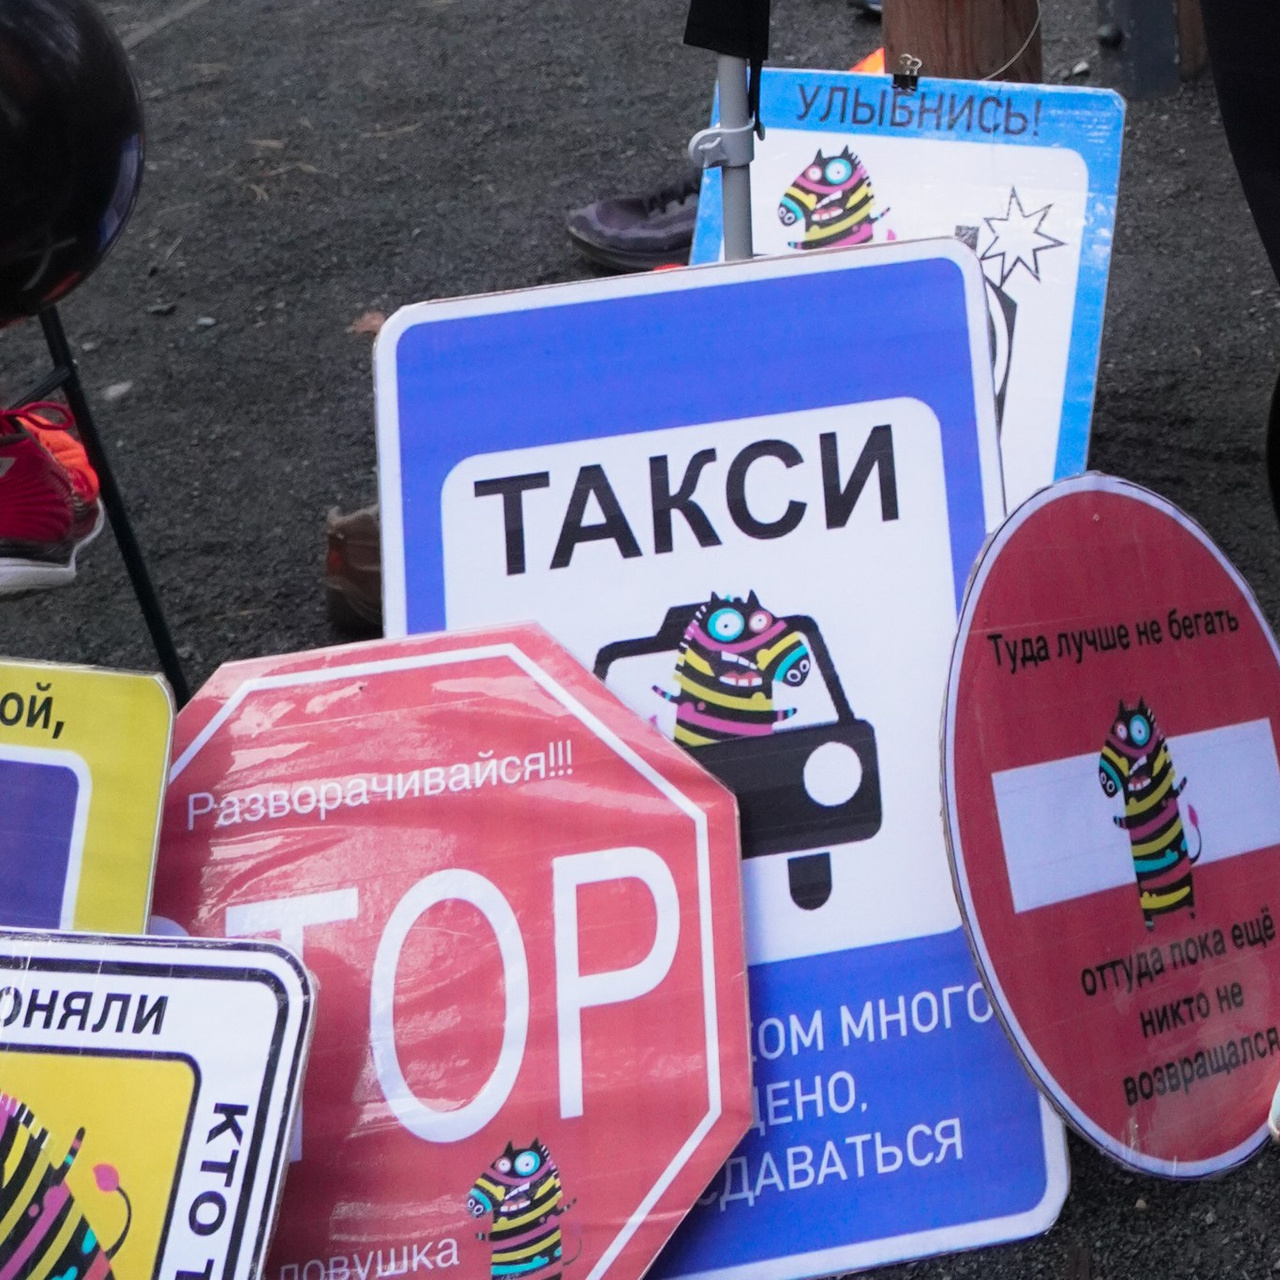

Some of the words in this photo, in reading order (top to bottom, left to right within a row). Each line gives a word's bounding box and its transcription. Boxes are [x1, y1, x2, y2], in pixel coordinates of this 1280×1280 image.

[796, 82, 1042, 137] УЛЫБНИСЬ!
[473, 424, 899, 576] ТАКСИ
[986, 633, 1050, 675] Туда
[1056, 623, 1131, 664] лучше
[1135, 618, 1163, 647] не
[1167, 608, 1239, 642] бегать
[186, 740, 574, 831] Разворачивайся!!!
[1081, 945, 1165, 997] оттуда
[1168, 927, 1227, 971] пока
[1230, 906, 1277, 948] ещё
[150, 846, 681, 1163] TOP
[751, 1008, 824, 1061] ОМ
[840, 982, 995, 1047] МНОГО
[1139, 992, 1211, 1039] никто
[1215, 981, 1245, 1014] не
[189, 1102, 250, 1237] КТО
